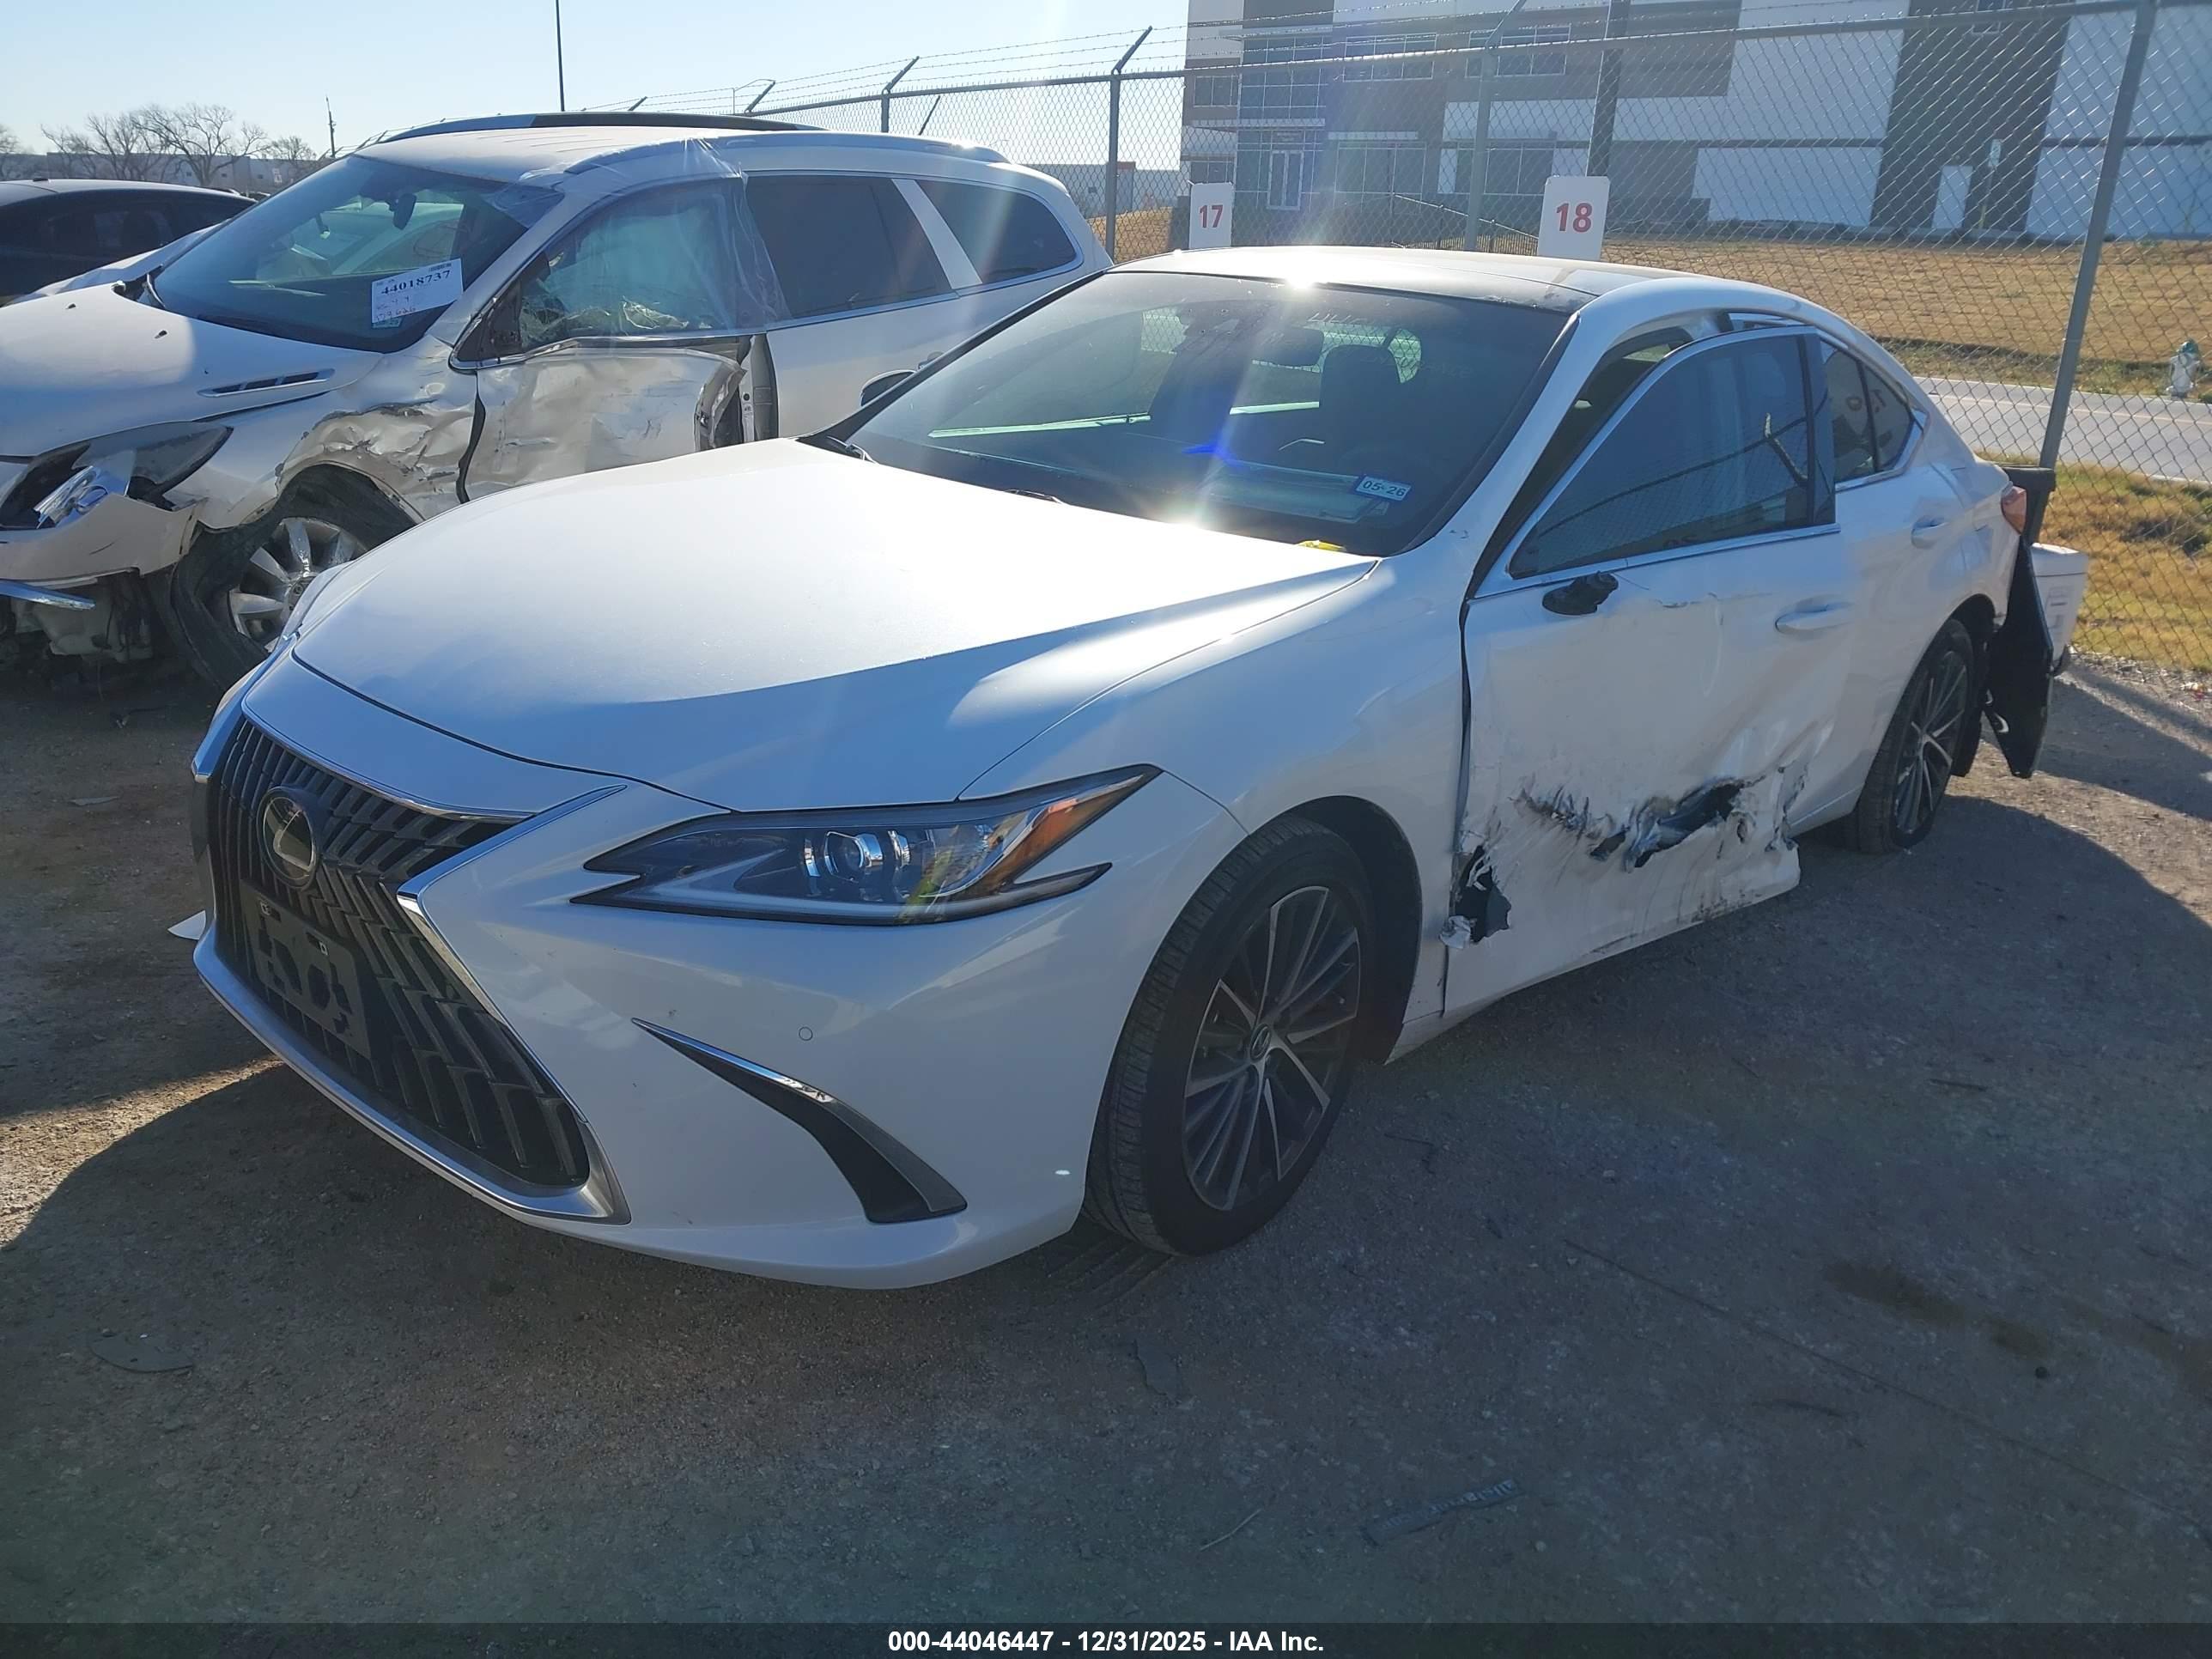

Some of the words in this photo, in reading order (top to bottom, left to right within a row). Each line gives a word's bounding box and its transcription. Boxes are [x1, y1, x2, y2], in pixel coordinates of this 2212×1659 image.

[1199, 204, 1224, 228] 17
[1555, 202, 1593, 233] 18
[380, 270, 451, 295] 44018737
